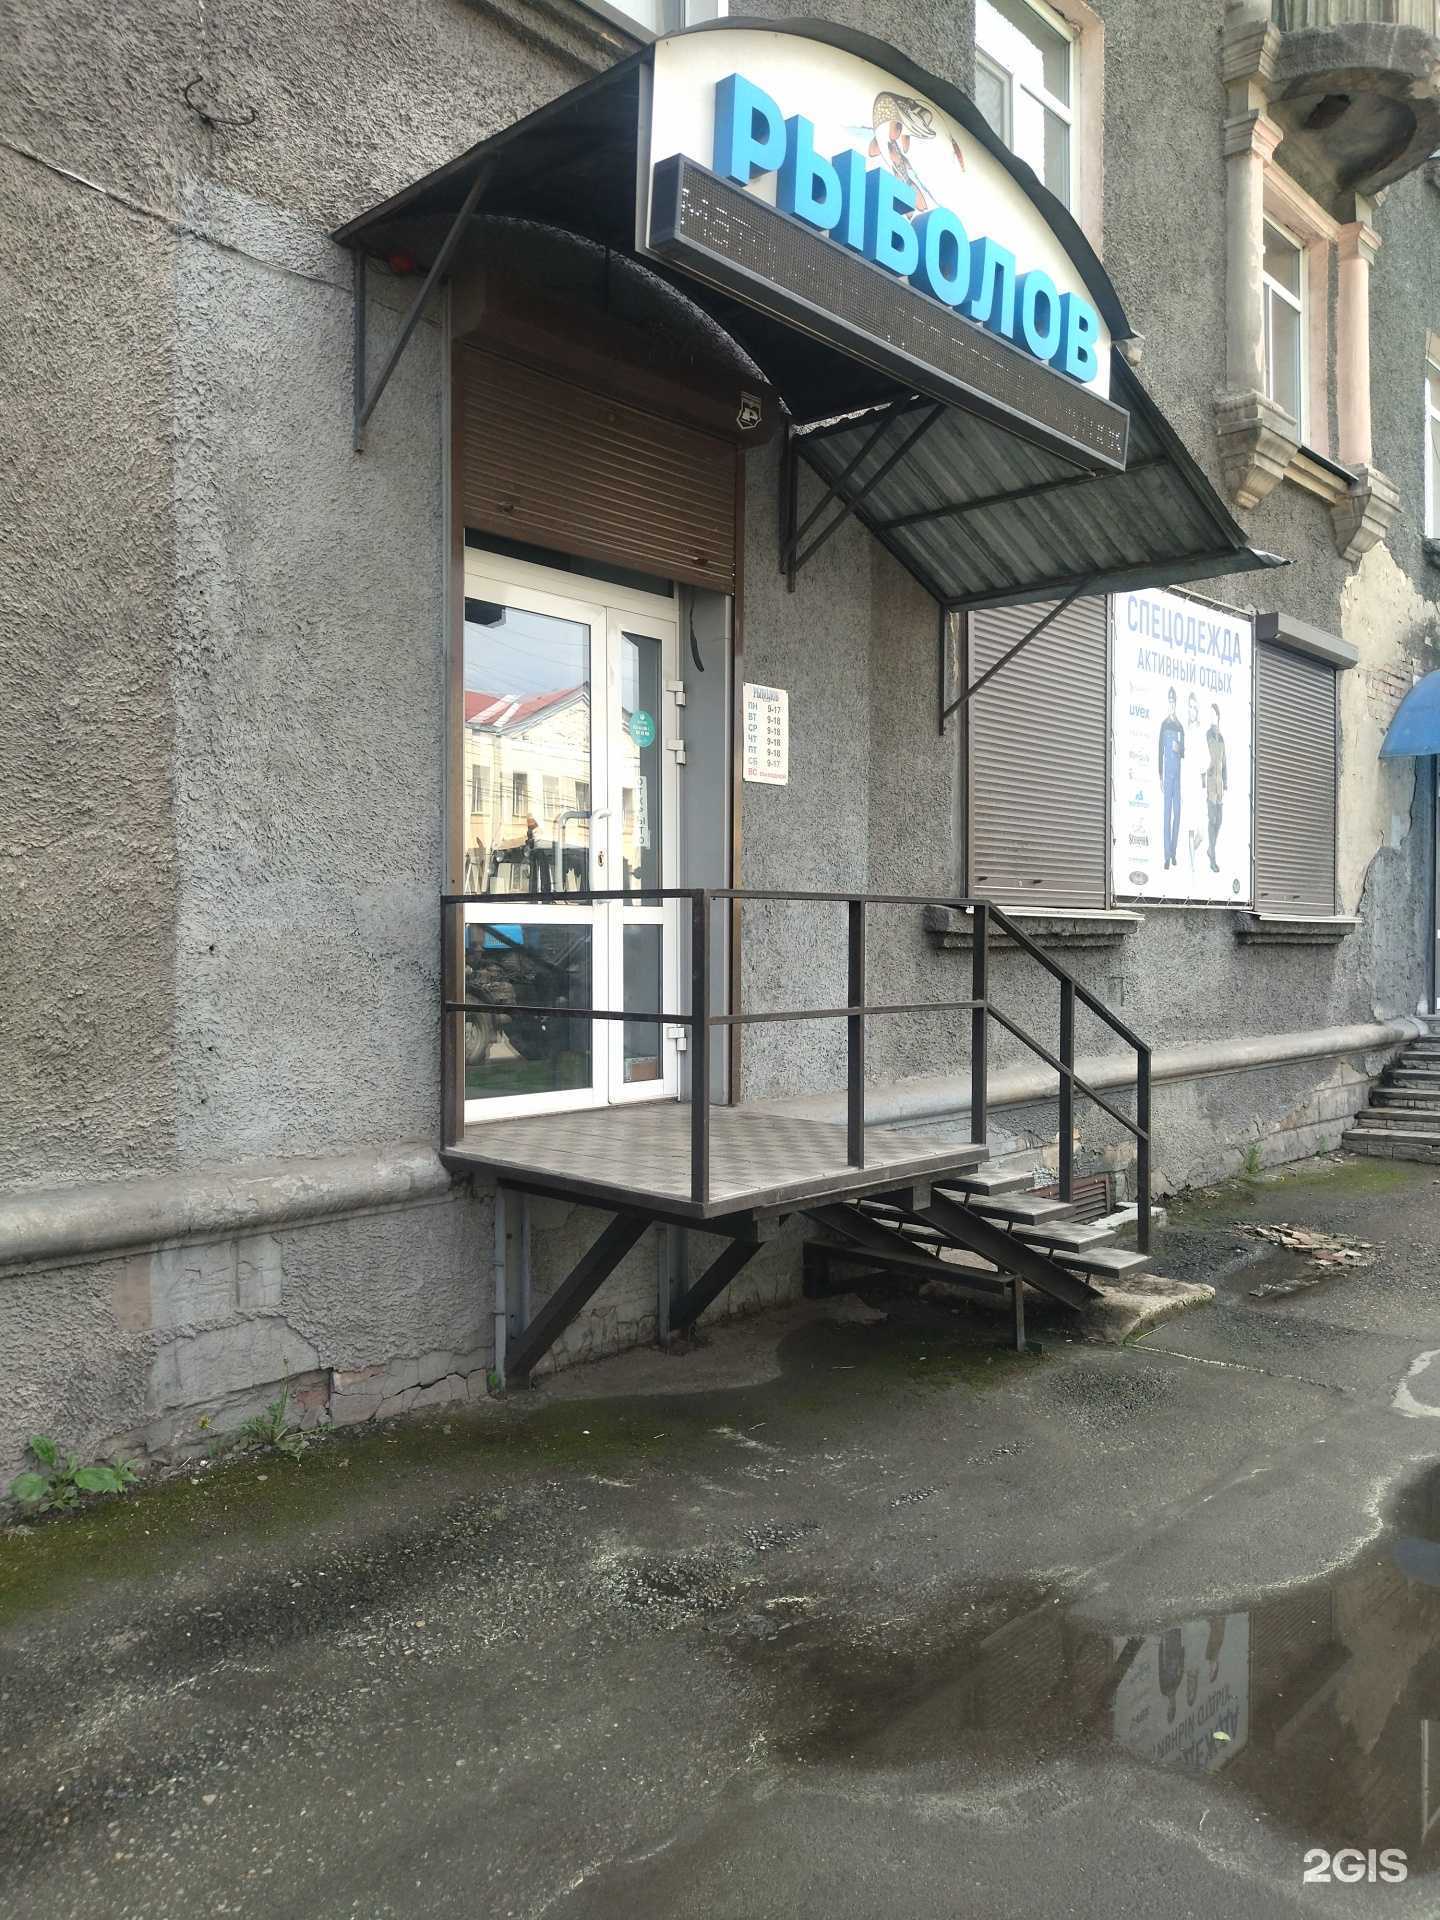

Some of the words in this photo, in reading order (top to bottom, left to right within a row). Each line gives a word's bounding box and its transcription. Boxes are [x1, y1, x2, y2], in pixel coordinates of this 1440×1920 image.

[716, 73, 1098, 382] РЫБОЛОВ
[1127, 595, 1242, 667] СПЕЦОДЕЖДА
[1137, 648, 1196, 685] АКТИВНЫЙ
[1199, 666, 1233, 695] ОТДЫХ
[748, 724, 758, 732] СР
[1129, 703, 1151, 721] uvex
[748, 735, 757, 743] ЧТ
